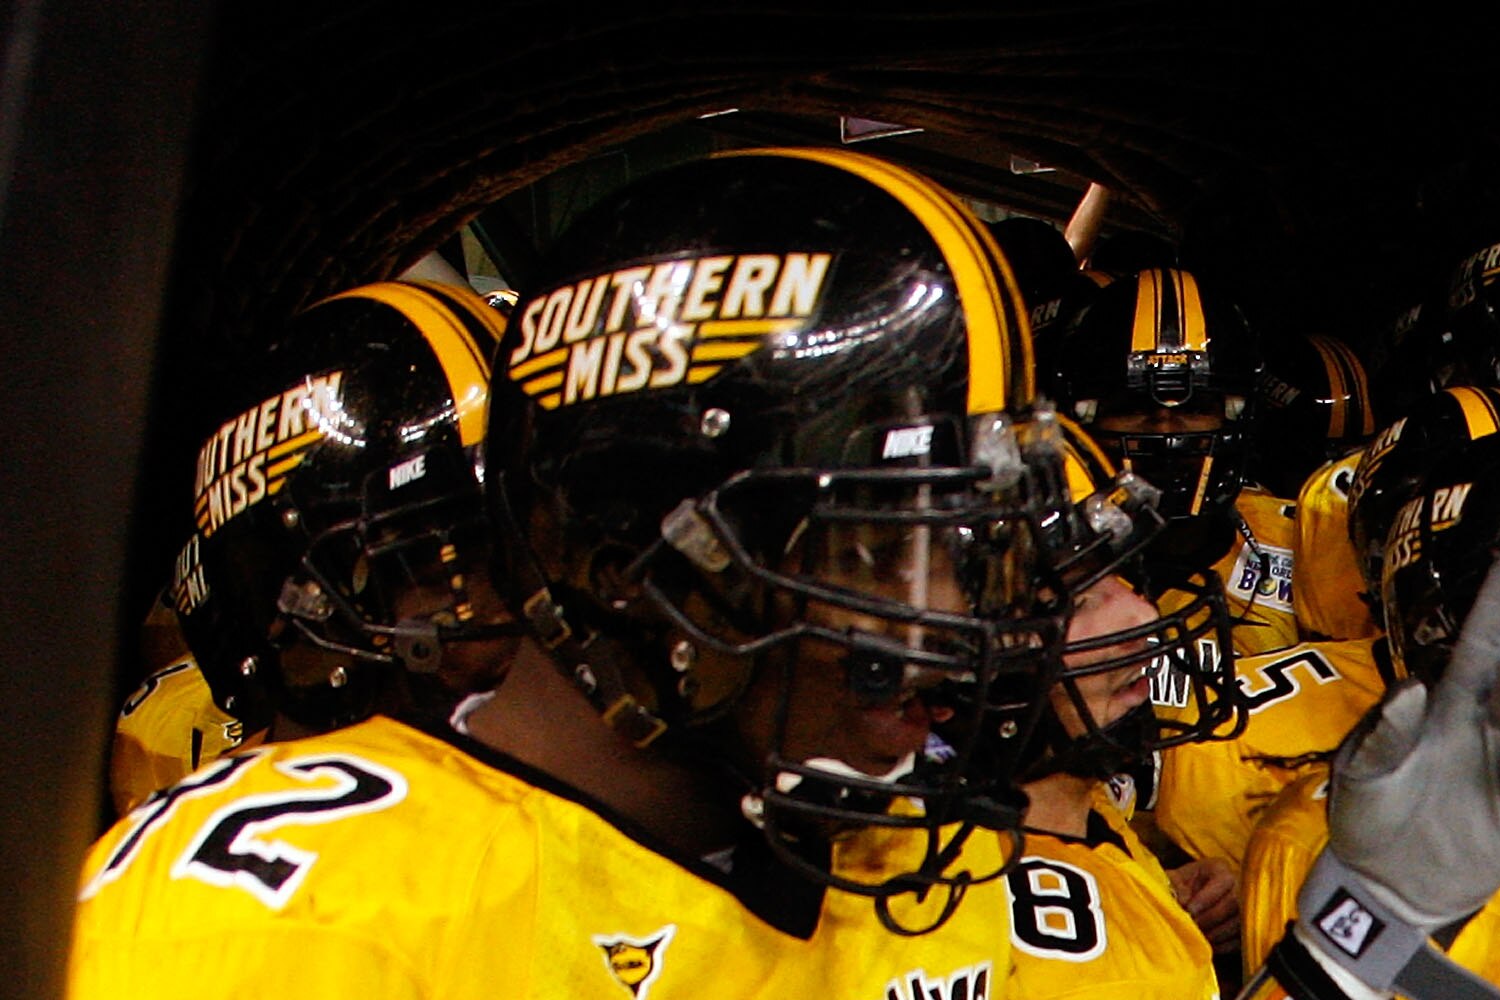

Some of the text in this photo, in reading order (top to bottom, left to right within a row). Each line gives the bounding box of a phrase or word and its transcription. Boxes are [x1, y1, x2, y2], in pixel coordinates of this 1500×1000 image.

[509, 252, 834, 366] SOUTHERN
[563, 322, 697, 406] MISS
[206, 451, 268, 533] MISS
[389, 454, 427, 491] NIKE
[1003, 854, 1107, 963] 8
